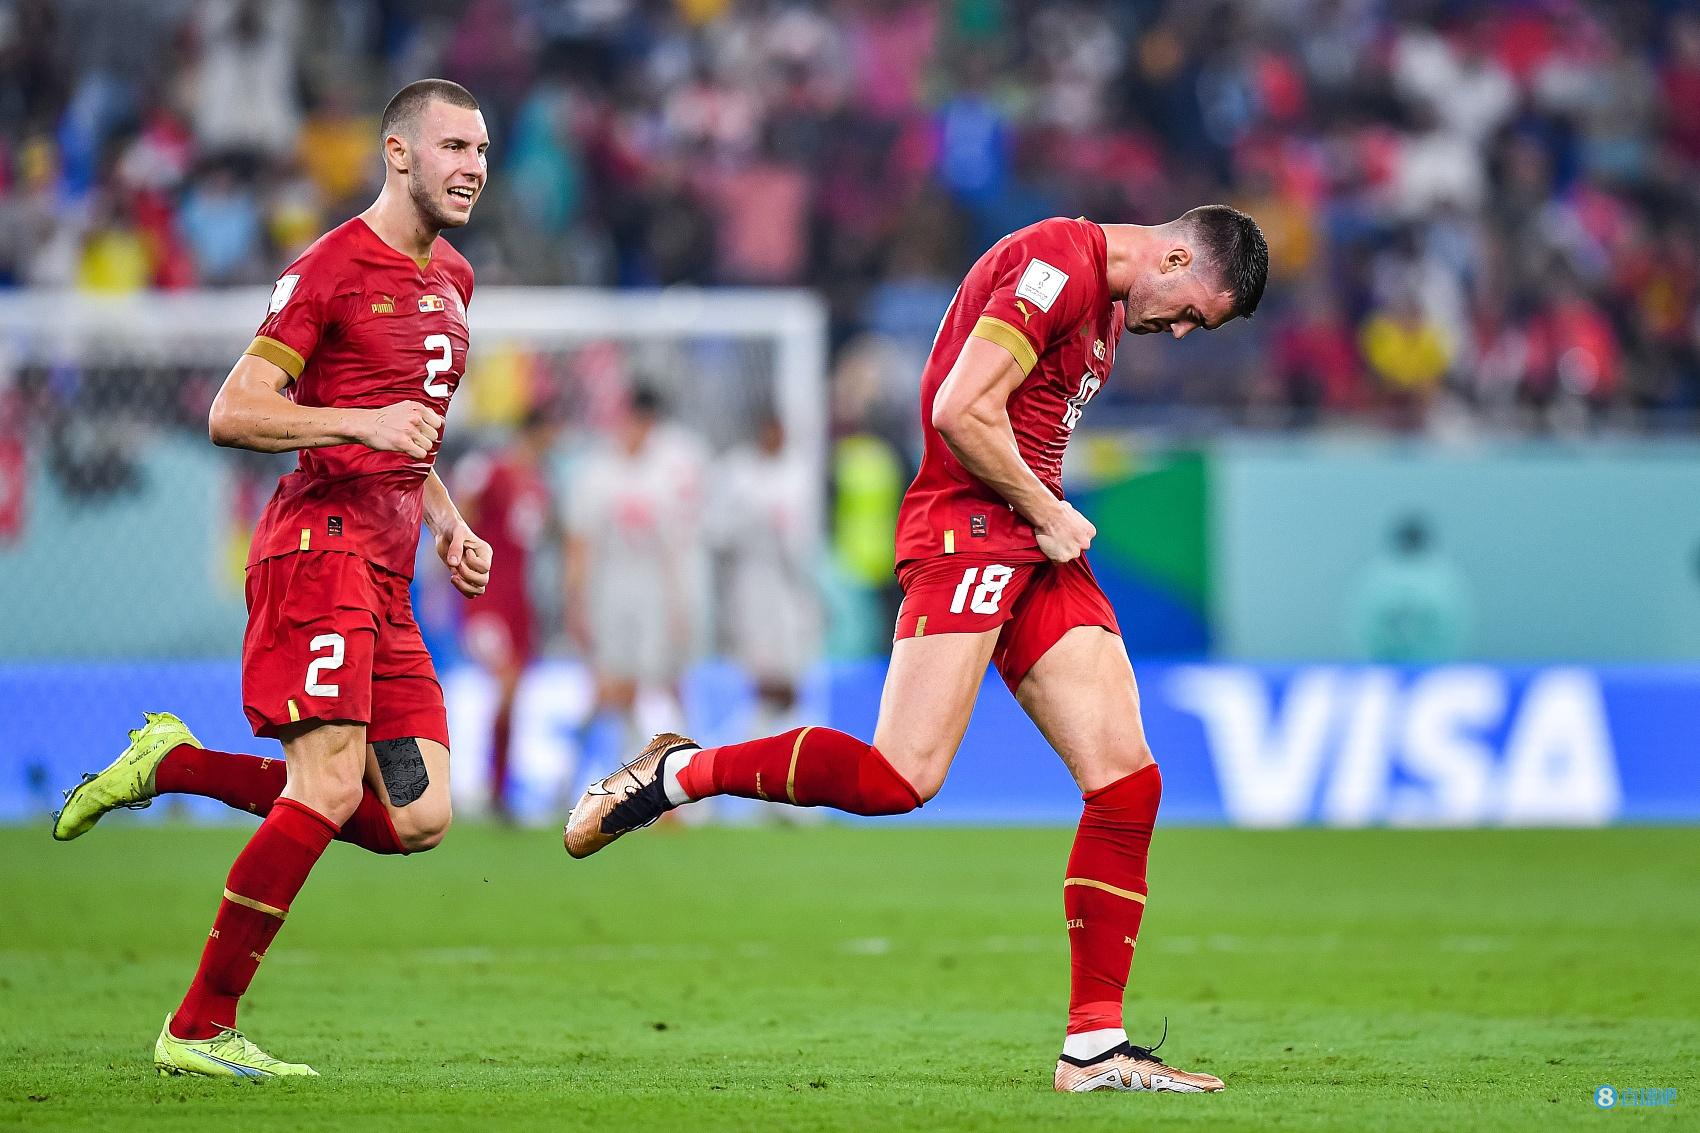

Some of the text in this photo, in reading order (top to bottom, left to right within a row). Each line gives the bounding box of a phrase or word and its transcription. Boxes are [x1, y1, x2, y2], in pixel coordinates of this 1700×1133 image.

[424, 333, 453, 398] 2
[949, 564, 1015, 615] 18
[304, 633, 345, 698] 2
[1167, 666, 1621, 826] VISA
